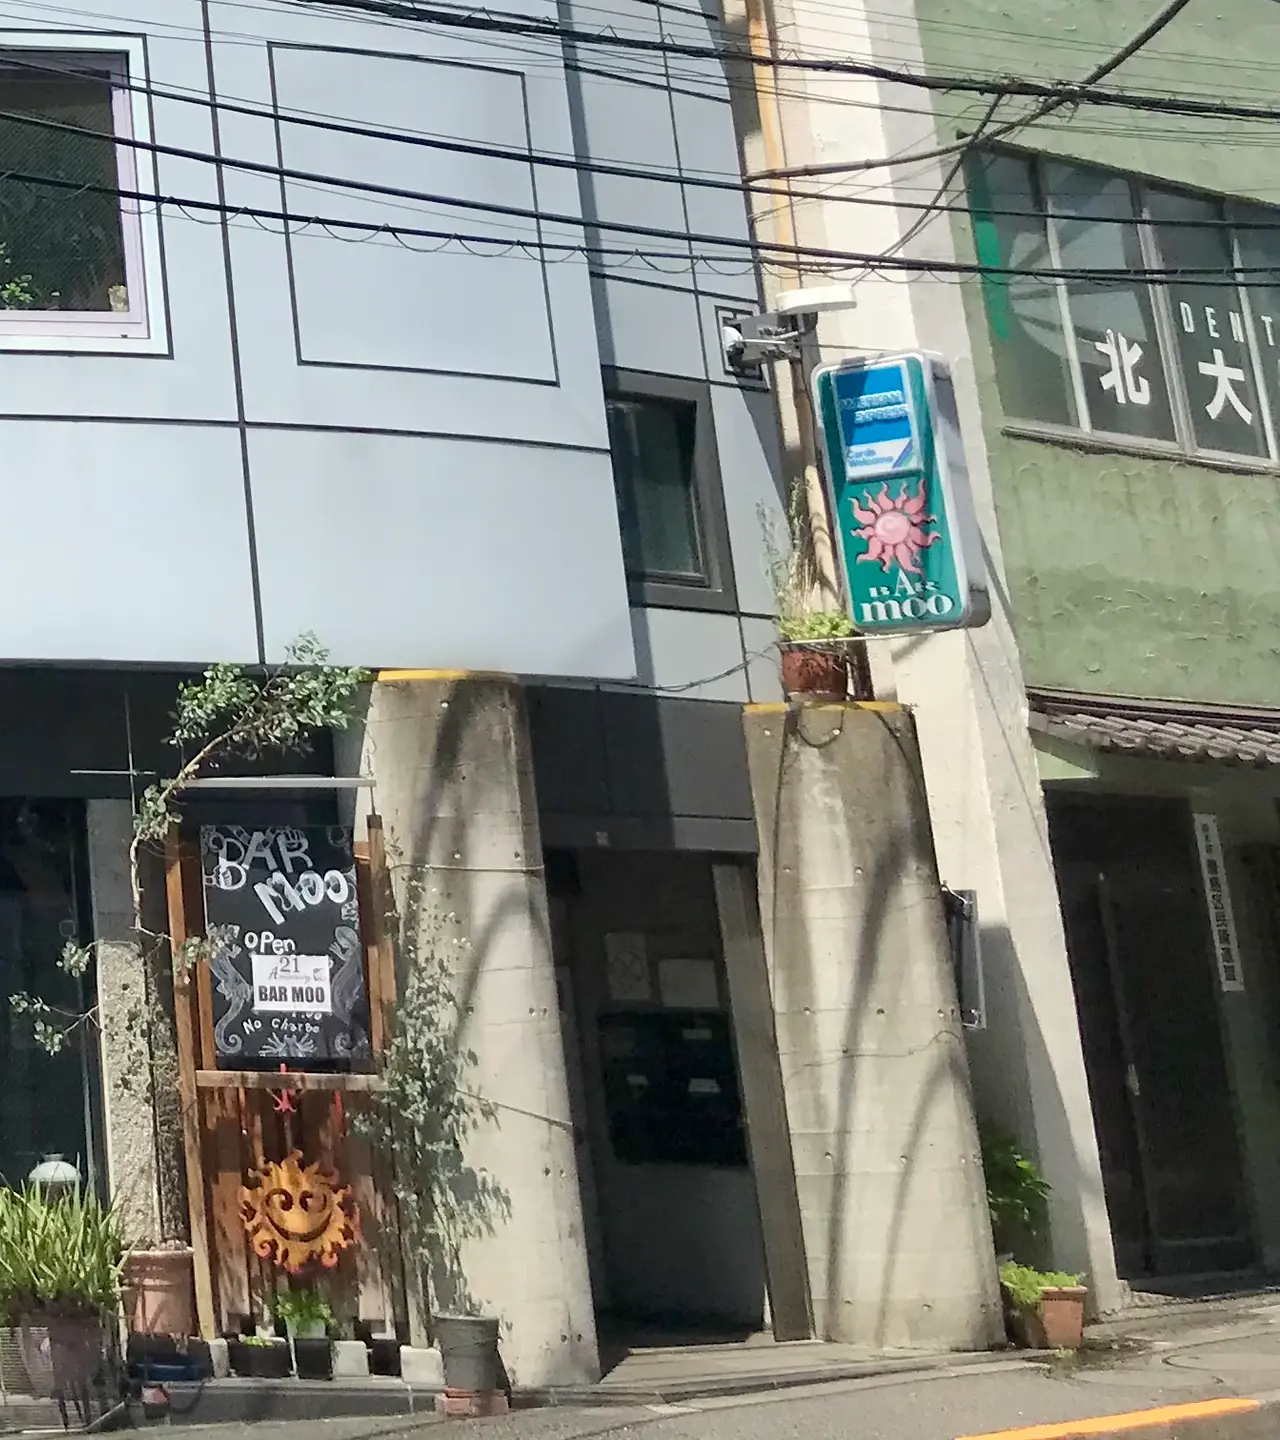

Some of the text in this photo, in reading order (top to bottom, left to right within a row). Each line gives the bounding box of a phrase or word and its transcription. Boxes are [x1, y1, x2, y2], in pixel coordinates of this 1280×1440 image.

[279, 956, 300, 972] 21
[258, 985, 325, 1003] BAR MOO
[242, 1018, 262, 1035] No
